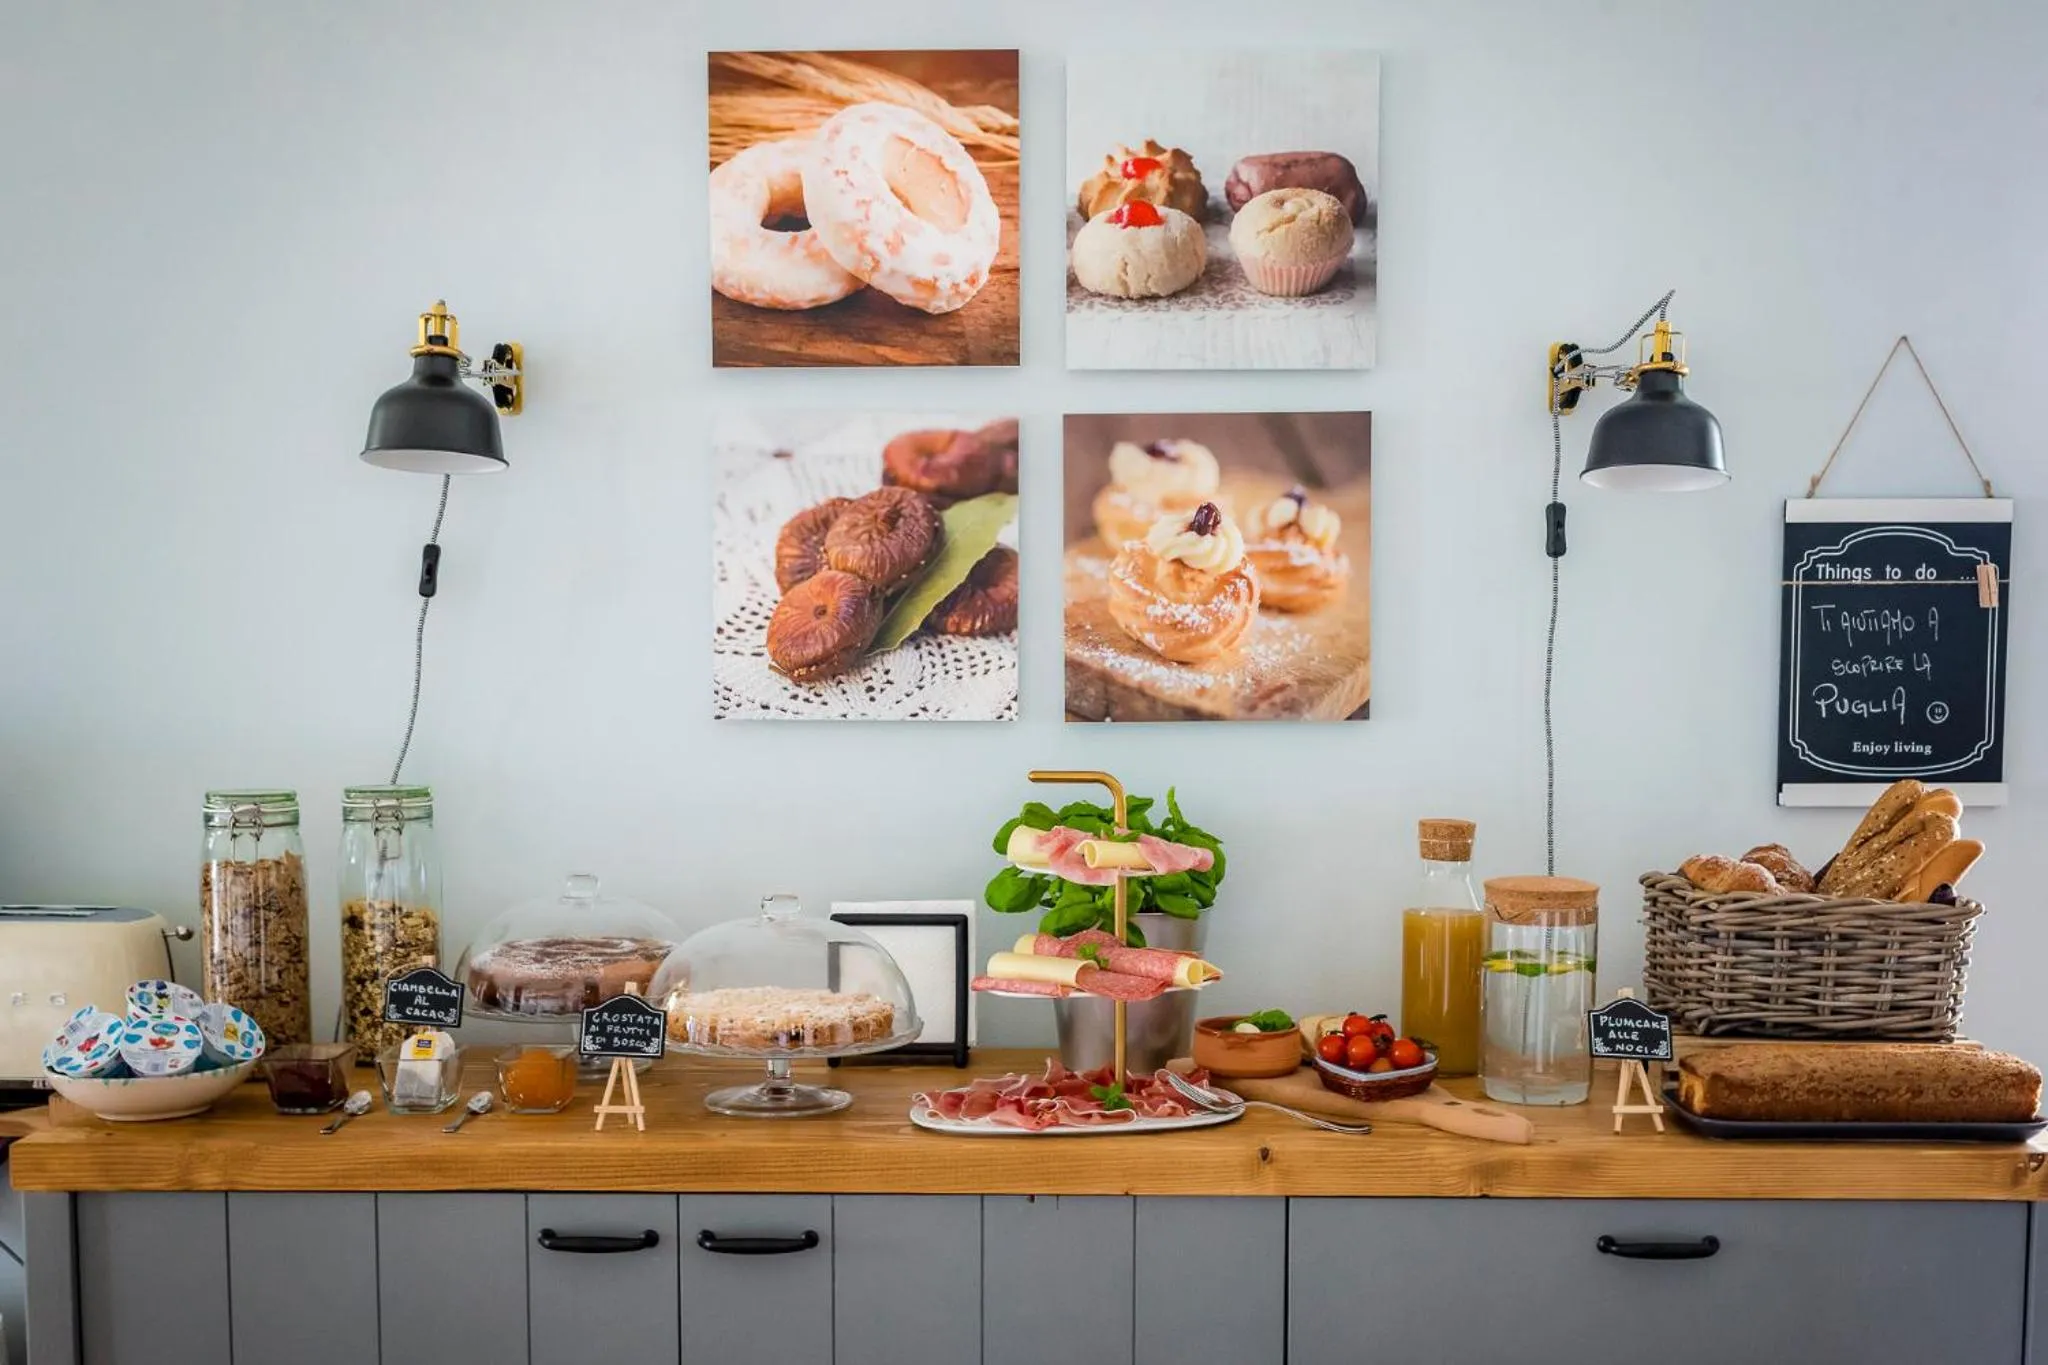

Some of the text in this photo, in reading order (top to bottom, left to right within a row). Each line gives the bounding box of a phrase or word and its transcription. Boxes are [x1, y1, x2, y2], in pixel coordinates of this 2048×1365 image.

[1815, 563, 1872, 582] Things
[1885, 564, 1901, 580] to
[1915, 563, 1937, 580] do
[1841, 609, 1915, 648] AIUTIAMO
[1928, 606, 1939, 641] A
[1831, 652, 1931, 681] SCOPRIRE LA
[1812, 683, 1906, 725] PUGLIA
[1852, 741, 1932, 755] Enjoy living
[390, 982, 458, 998] CIAMBELLA
[413, 994, 430, 1006] AL
[405, 1007, 445, 1019] CACAO
[592, 1012, 660, 1025] CROSTATA
[589, 1024, 651, 1036] AI FRUTTI
[1599, 1015, 1669, 1031] PLUMCAKE
[1608, 1029, 1640, 1041] ALLE
[1615, 1043, 1649, 1054] NOCI
